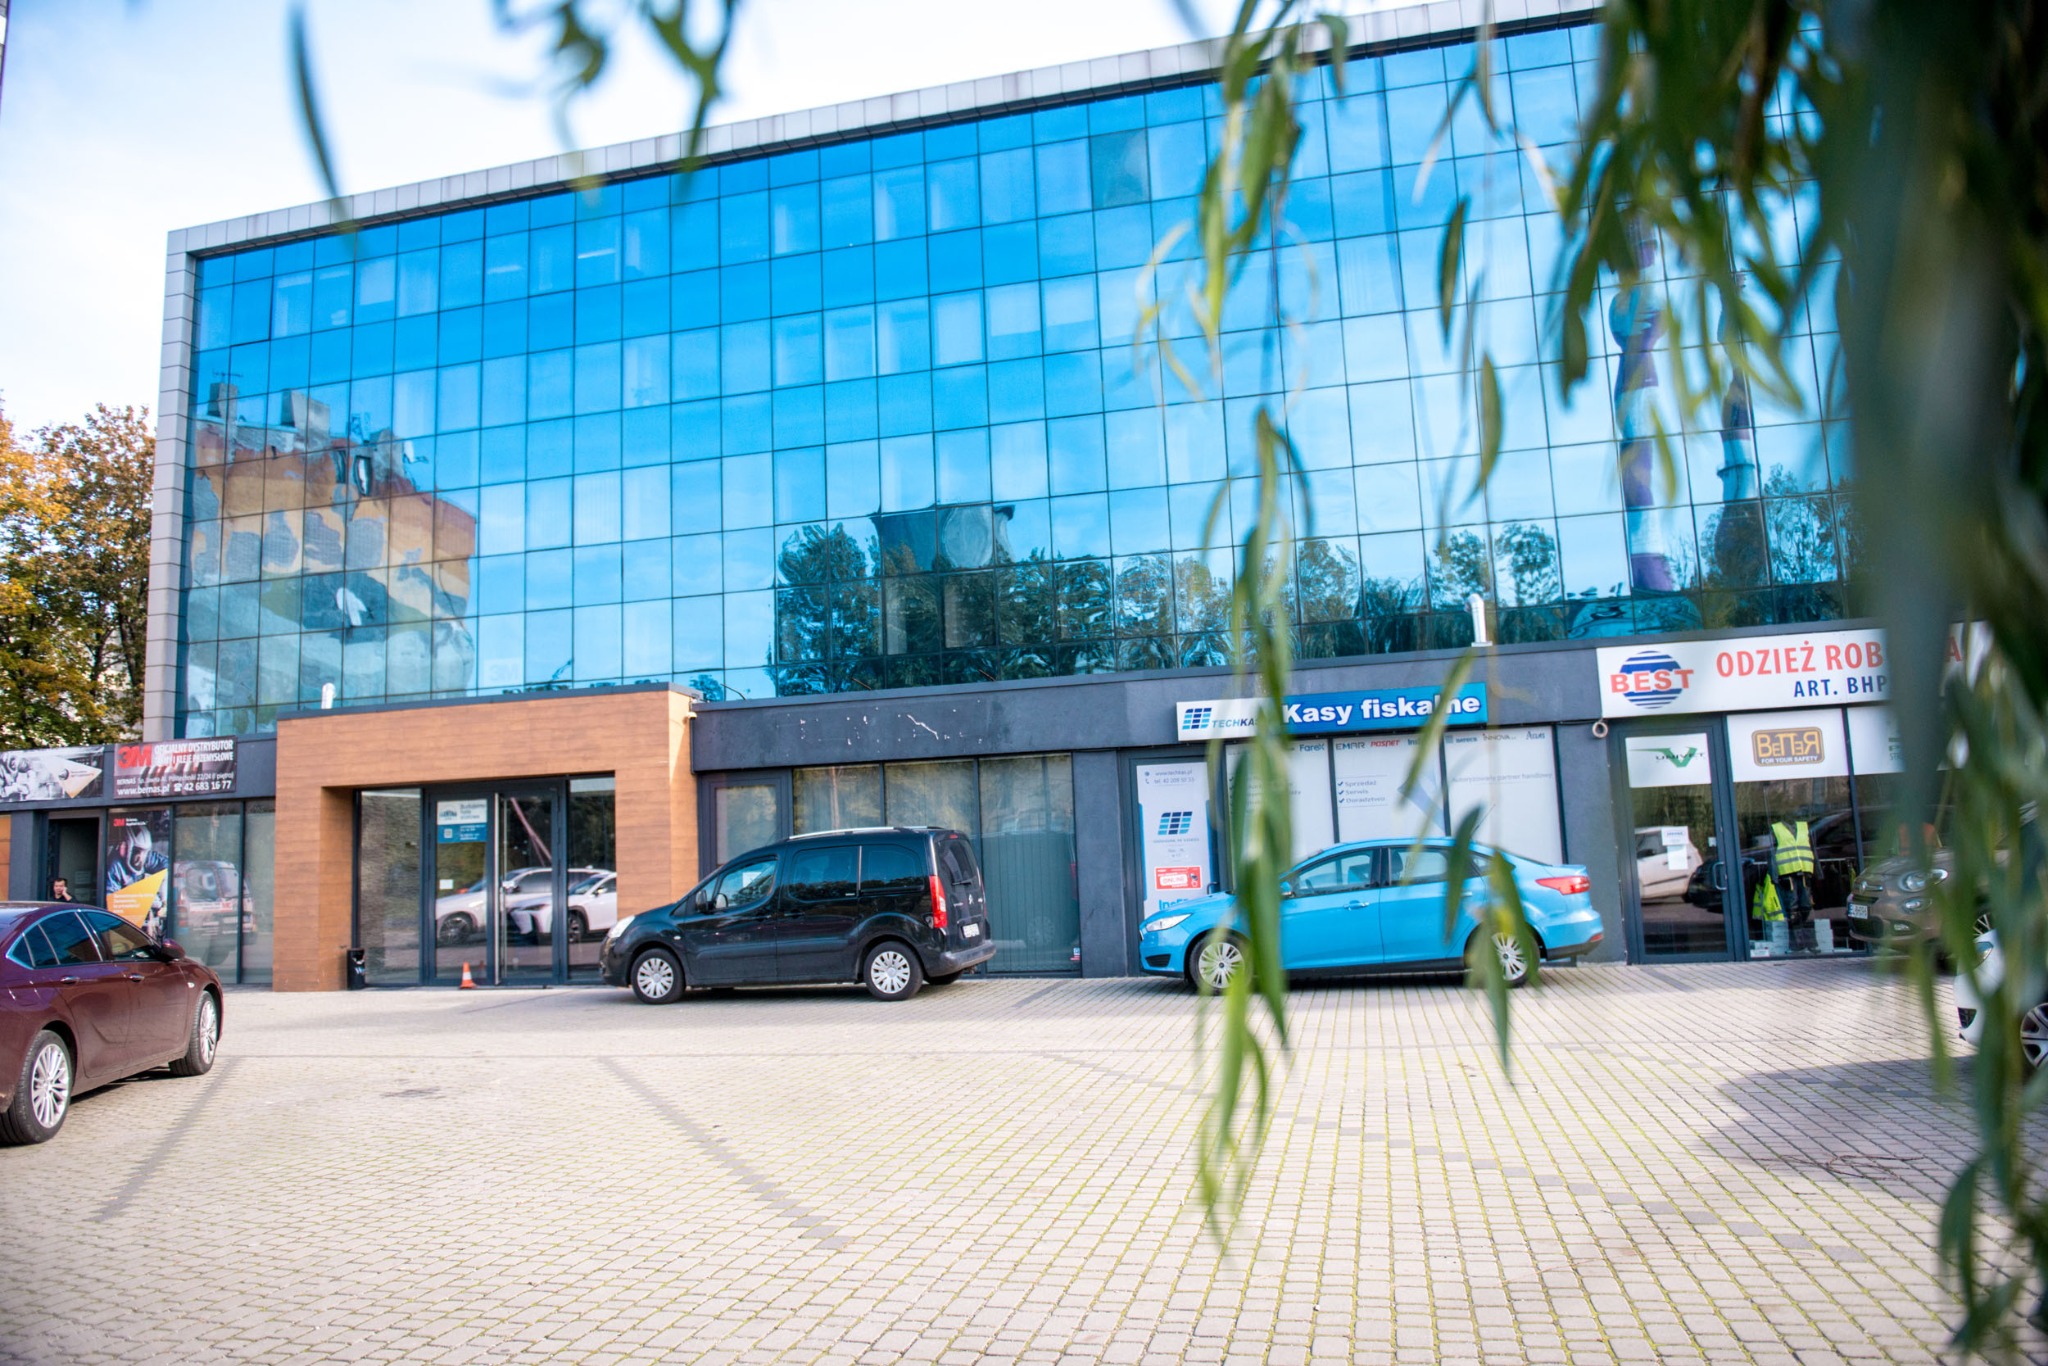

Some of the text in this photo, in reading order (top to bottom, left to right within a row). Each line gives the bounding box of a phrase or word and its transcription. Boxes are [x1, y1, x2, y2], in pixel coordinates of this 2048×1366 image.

[1716, 640, 1816, 677] ODZIEŻ
[1610, 669, 1694, 693] BEST
[1794, 675, 1887, 697] ART. BHP
[1282, 694, 1480, 725] Kasy fiskalne
[1211, 718, 1262, 728] TECHKA
[189, 740, 233, 751] DYSTRYBUTOR
[118, 746, 152, 768] 3M
[184, 783, 194, 791] 42
[195, 782, 209, 790] 683
[222, 780, 232, 789] 77
